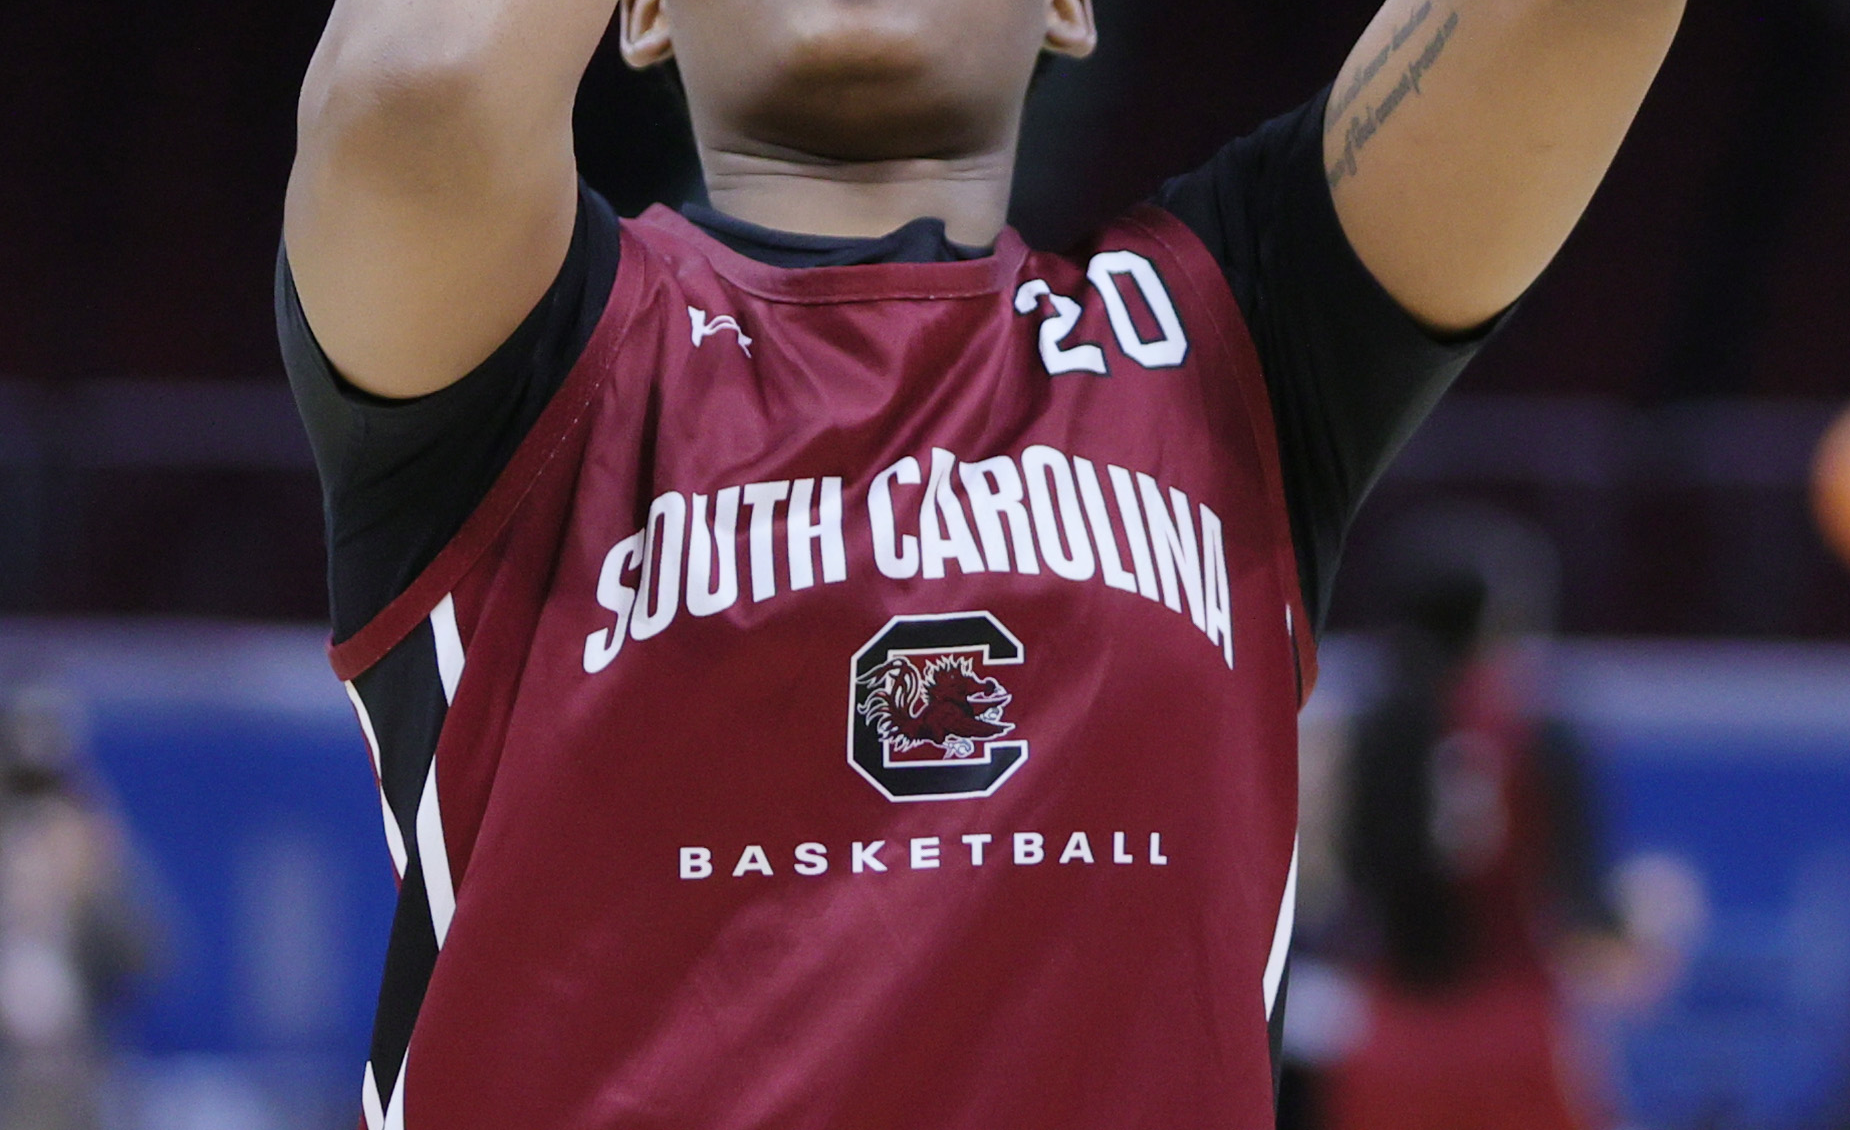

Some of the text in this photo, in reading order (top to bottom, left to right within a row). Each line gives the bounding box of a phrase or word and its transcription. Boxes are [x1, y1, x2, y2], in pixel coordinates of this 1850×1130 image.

[1014, 250, 1188, 375] 20
[583, 444, 1234, 674] SOUTH CAROLINA
[679, 831, 1168, 879] BASKETBALL
